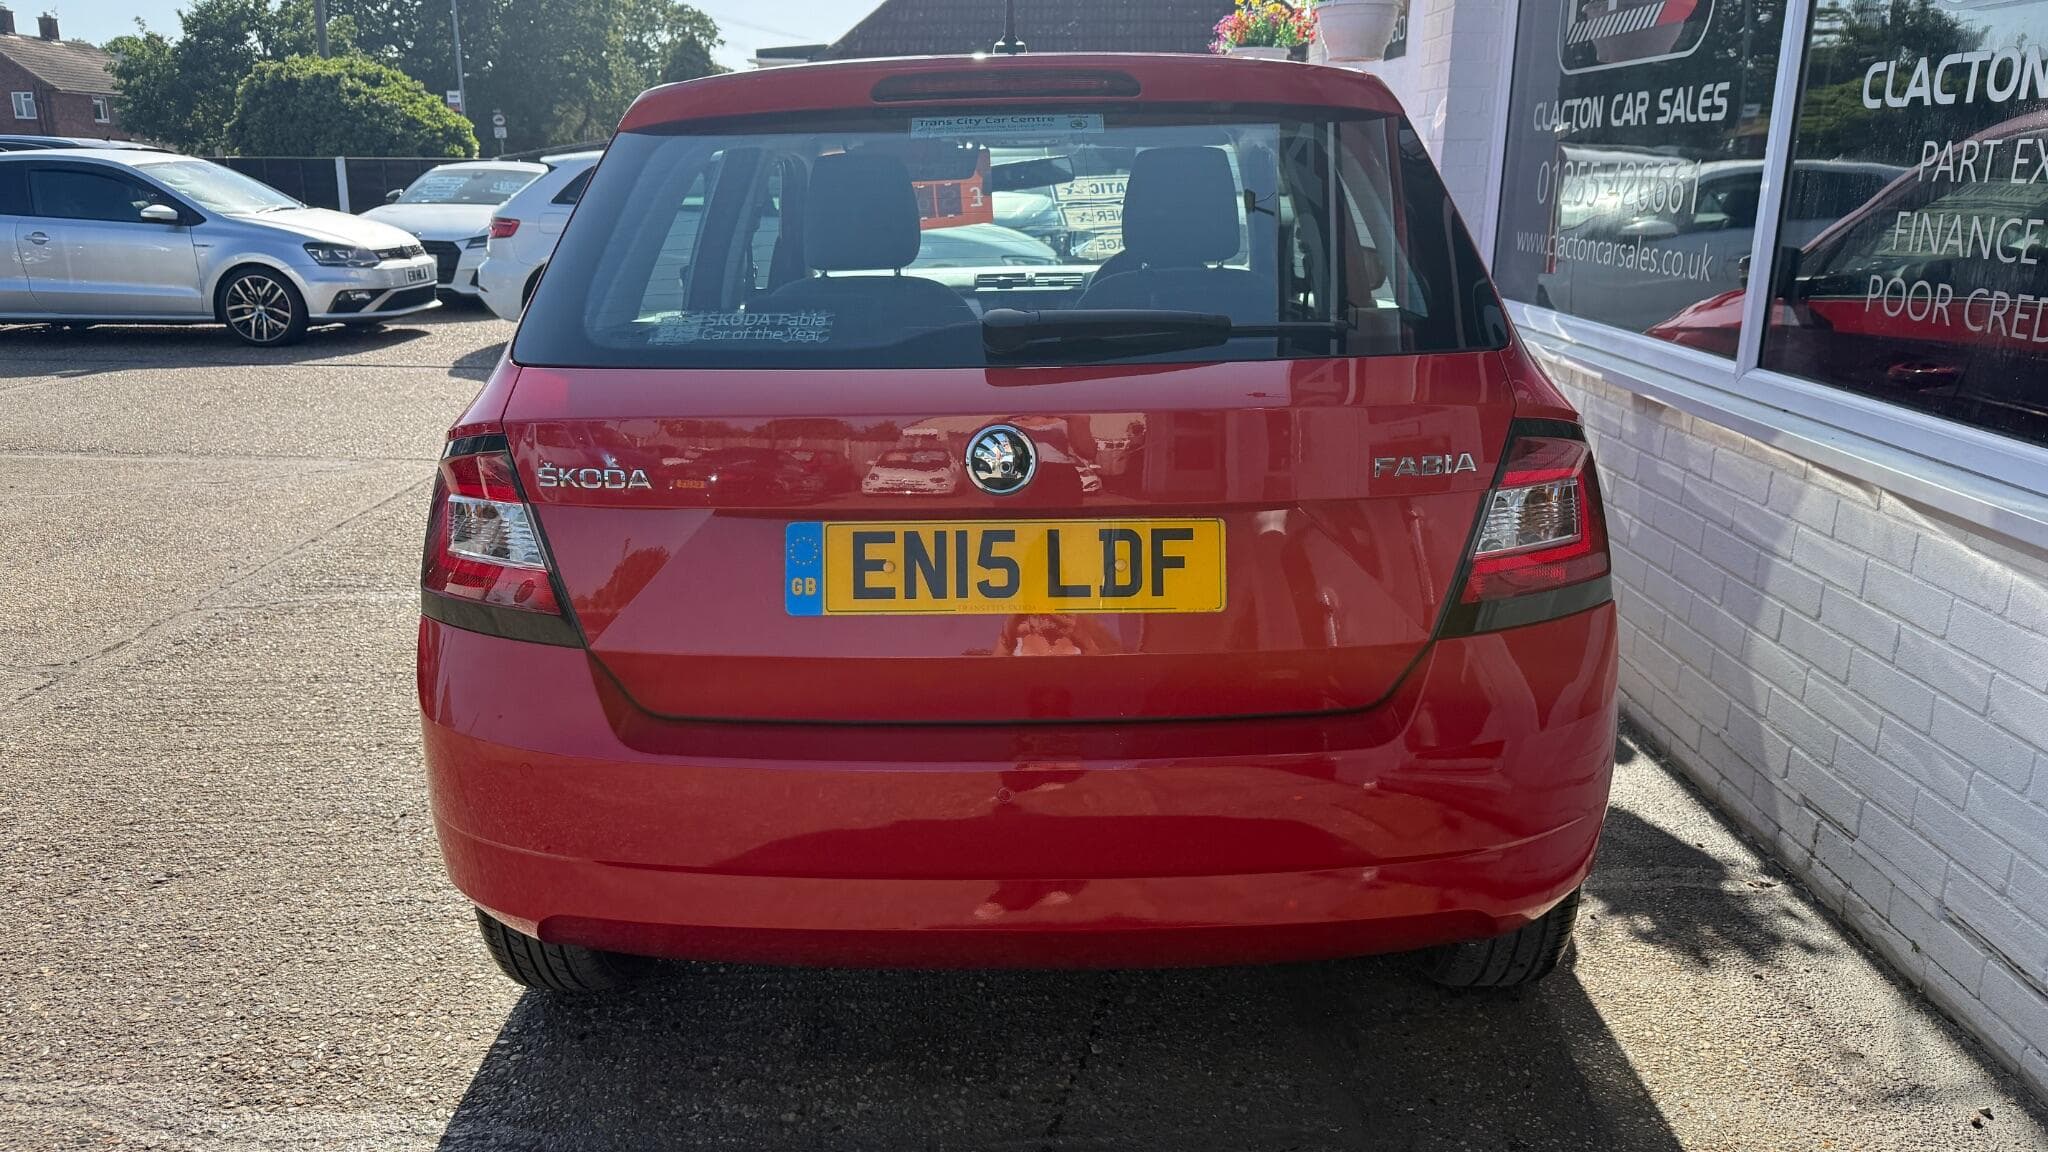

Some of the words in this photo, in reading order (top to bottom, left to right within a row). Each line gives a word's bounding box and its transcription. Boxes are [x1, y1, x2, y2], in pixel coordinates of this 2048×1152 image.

[1862, 44, 2048, 109] CLACTON
[919, 118, 952, 128] Trans
[956, 117, 982, 127] City
[985, 116, 1006, 124] Car
[1010, 115, 1055, 124] Centre
[1533, 95, 1604, 133] CLACTON
[1610, 90, 1650, 127] CAR
[1656, 81, 1730, 125] SALES
[1917, 140, 2003, 184] PART
[1516, 226, 1714, 282] www.clactoncarsales.co.uk
[1892, 211, 2045, 265] FINANCE
[777, 313, 828, 326] Fabia
[1865, 274, 1953, 326] POOR
[702, 328, 731, 340] Car
[732, 327, 752, 340] of
[755, 327, 784, 340] the
[787, 328, 823, 341] Year
[537, 462, 653, 489] ŠKODA
[1374, 453, 1477, 478] FABIA
[852, 529, 1020, 600] EN15
[1047, 527, 1194, 598] LDF
[791, 576, 817, 596] GB
